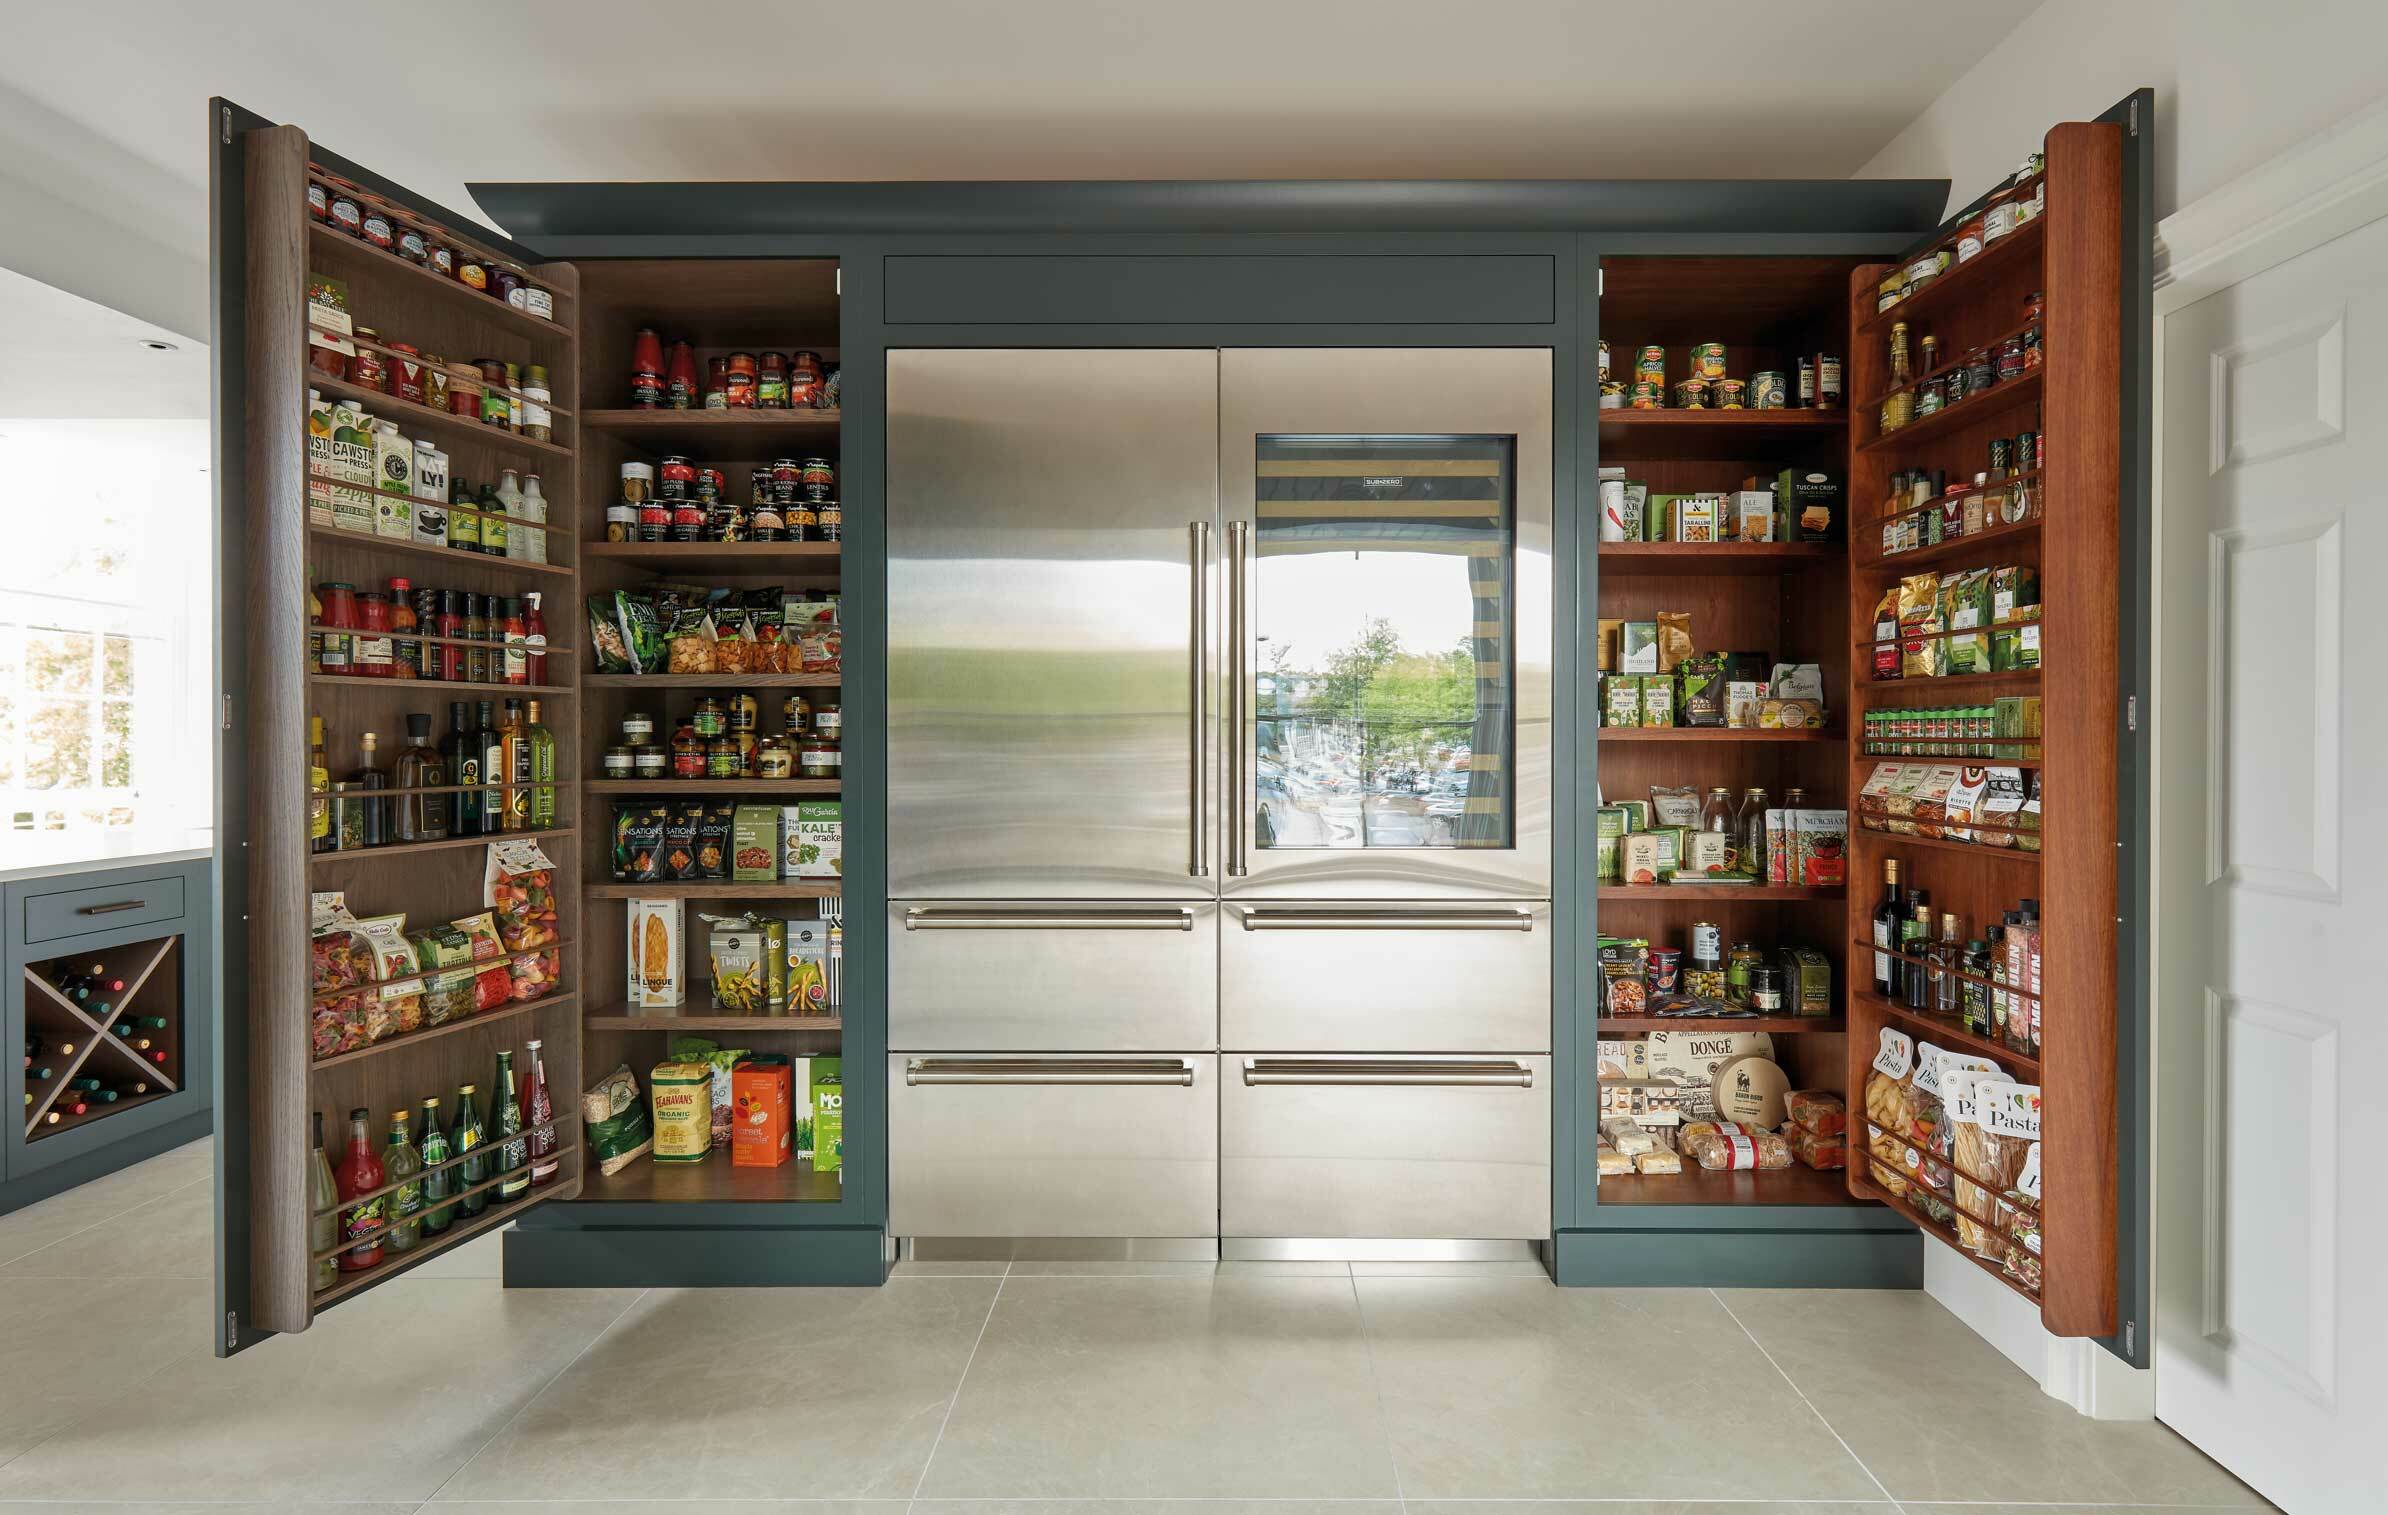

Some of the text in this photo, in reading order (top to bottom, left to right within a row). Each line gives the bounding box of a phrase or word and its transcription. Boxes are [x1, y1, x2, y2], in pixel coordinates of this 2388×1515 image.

[349, 459, 368, 470] PRESS
[421, 471, 444, 488] LY!
[801, 823, 836, 833] KALE
[721, 955, 750, 969] TWISTS
[1878, 1052, 1903, 1075] Pasta
[1990, 1110, 2040, 1133] Pasta
